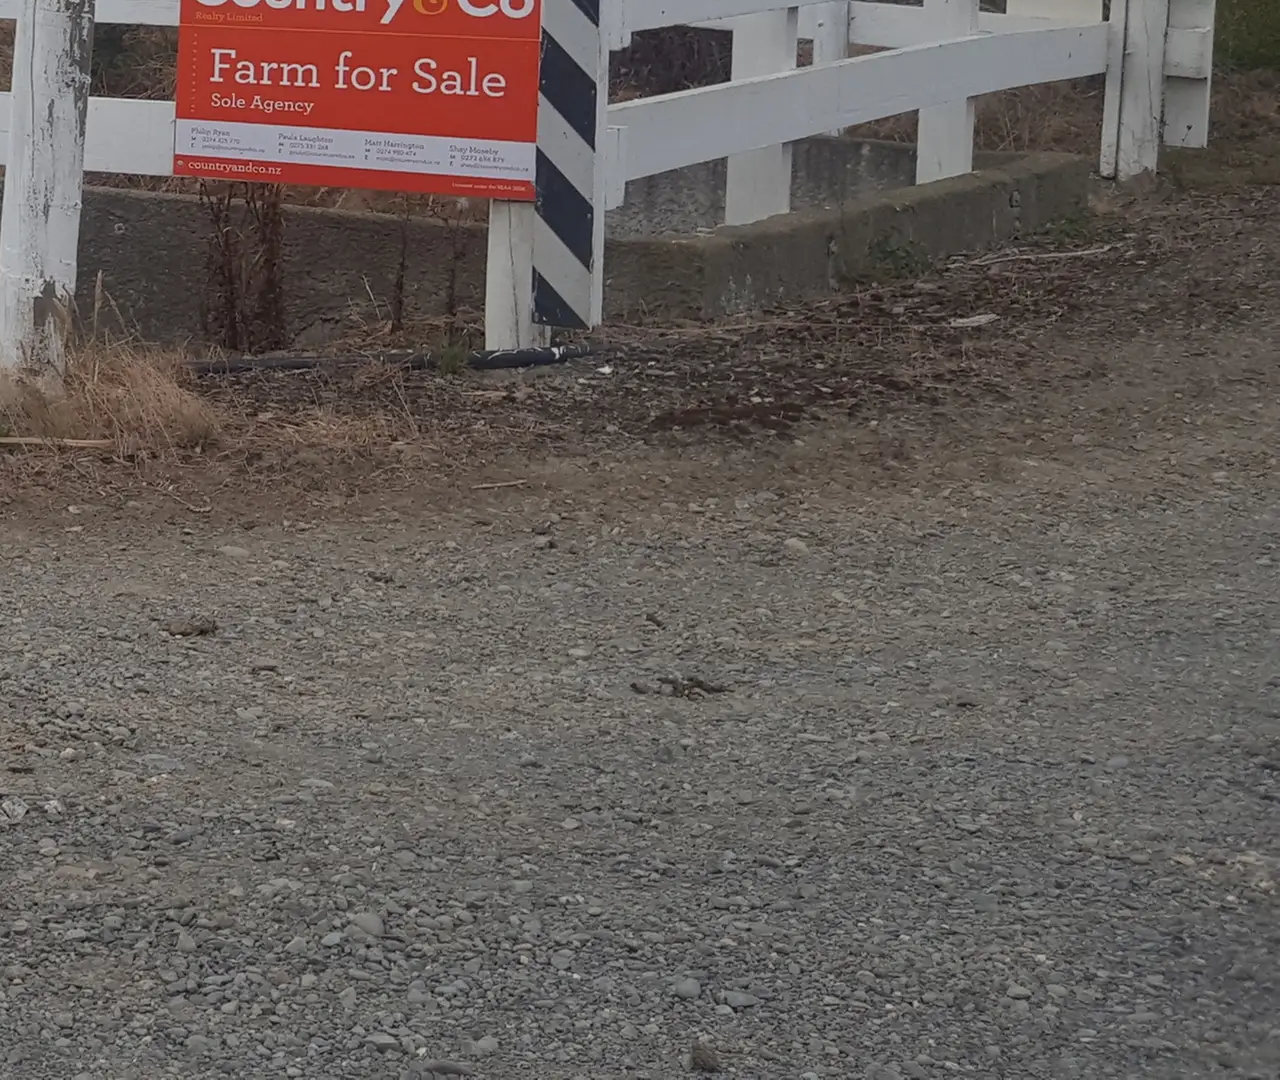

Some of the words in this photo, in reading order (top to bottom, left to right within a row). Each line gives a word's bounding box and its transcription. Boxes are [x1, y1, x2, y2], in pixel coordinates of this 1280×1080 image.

[226, 13, 263, 22] Limited
[209, 48, 320, 88] Farm
[334, 51, 398, 92] for
[412, 57, 506, 97] Sale
[211, 92, 246, 109] Sole
[250, 95, 314, 115] Agency
[212, 129, 230, 137] Ryan
[364, 139, 382, 147] Matt
[383, 140, 425, 150] Harrington
[449, 144, 468, 154] Shay
[188, 161, 282, 175] countryandco.nz
